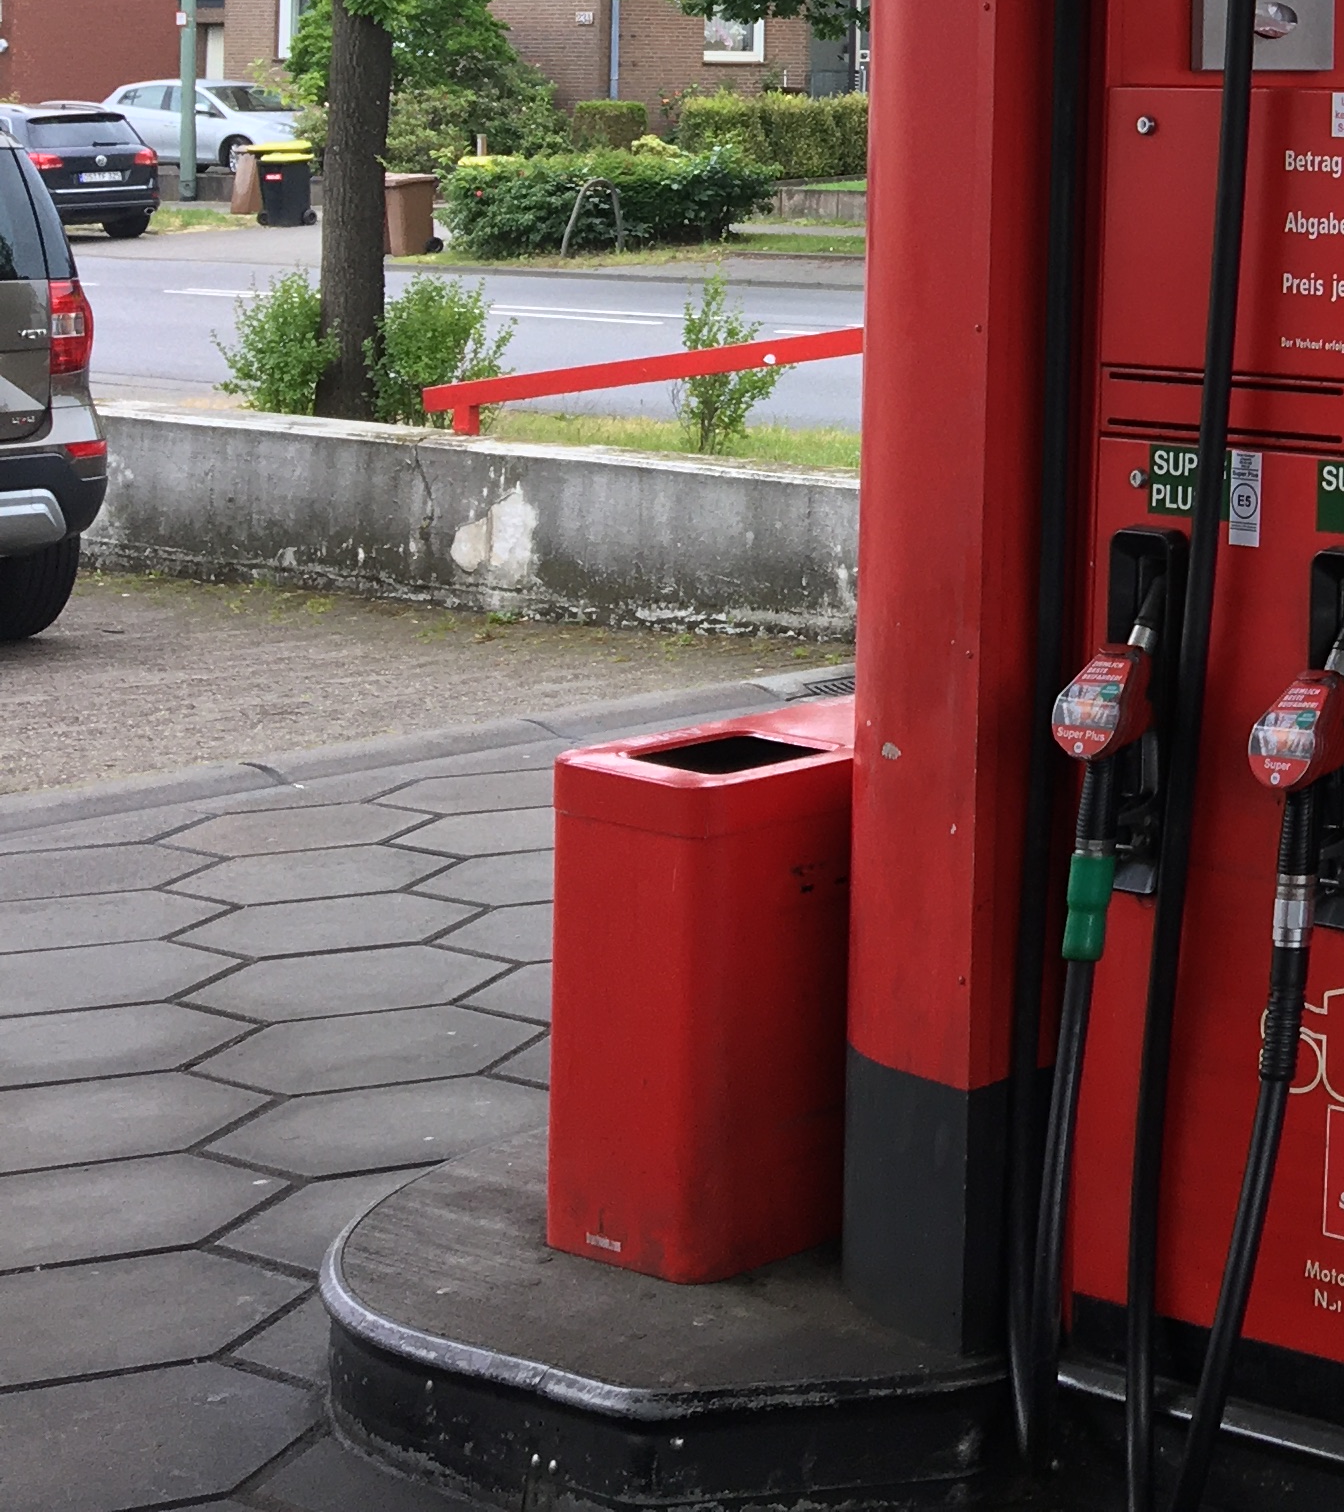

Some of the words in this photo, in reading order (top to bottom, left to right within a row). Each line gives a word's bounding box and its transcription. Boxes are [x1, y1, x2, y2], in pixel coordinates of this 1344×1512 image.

[1285, 150, 1343, 178] Betrag
[1282, 273, 1324, 297] Preis
[1281, 336, 1293, 348] Der
[1295, 337, 1322, 350] Verkauf
[1151, 483, 1195, 510] PLU
[1237, 494, 1251, 508] E5
[1056, 726, 1084, 741] Super
[1085, 729, 1105, 742] Plus
[1263, 758, 1291, 773] Super
